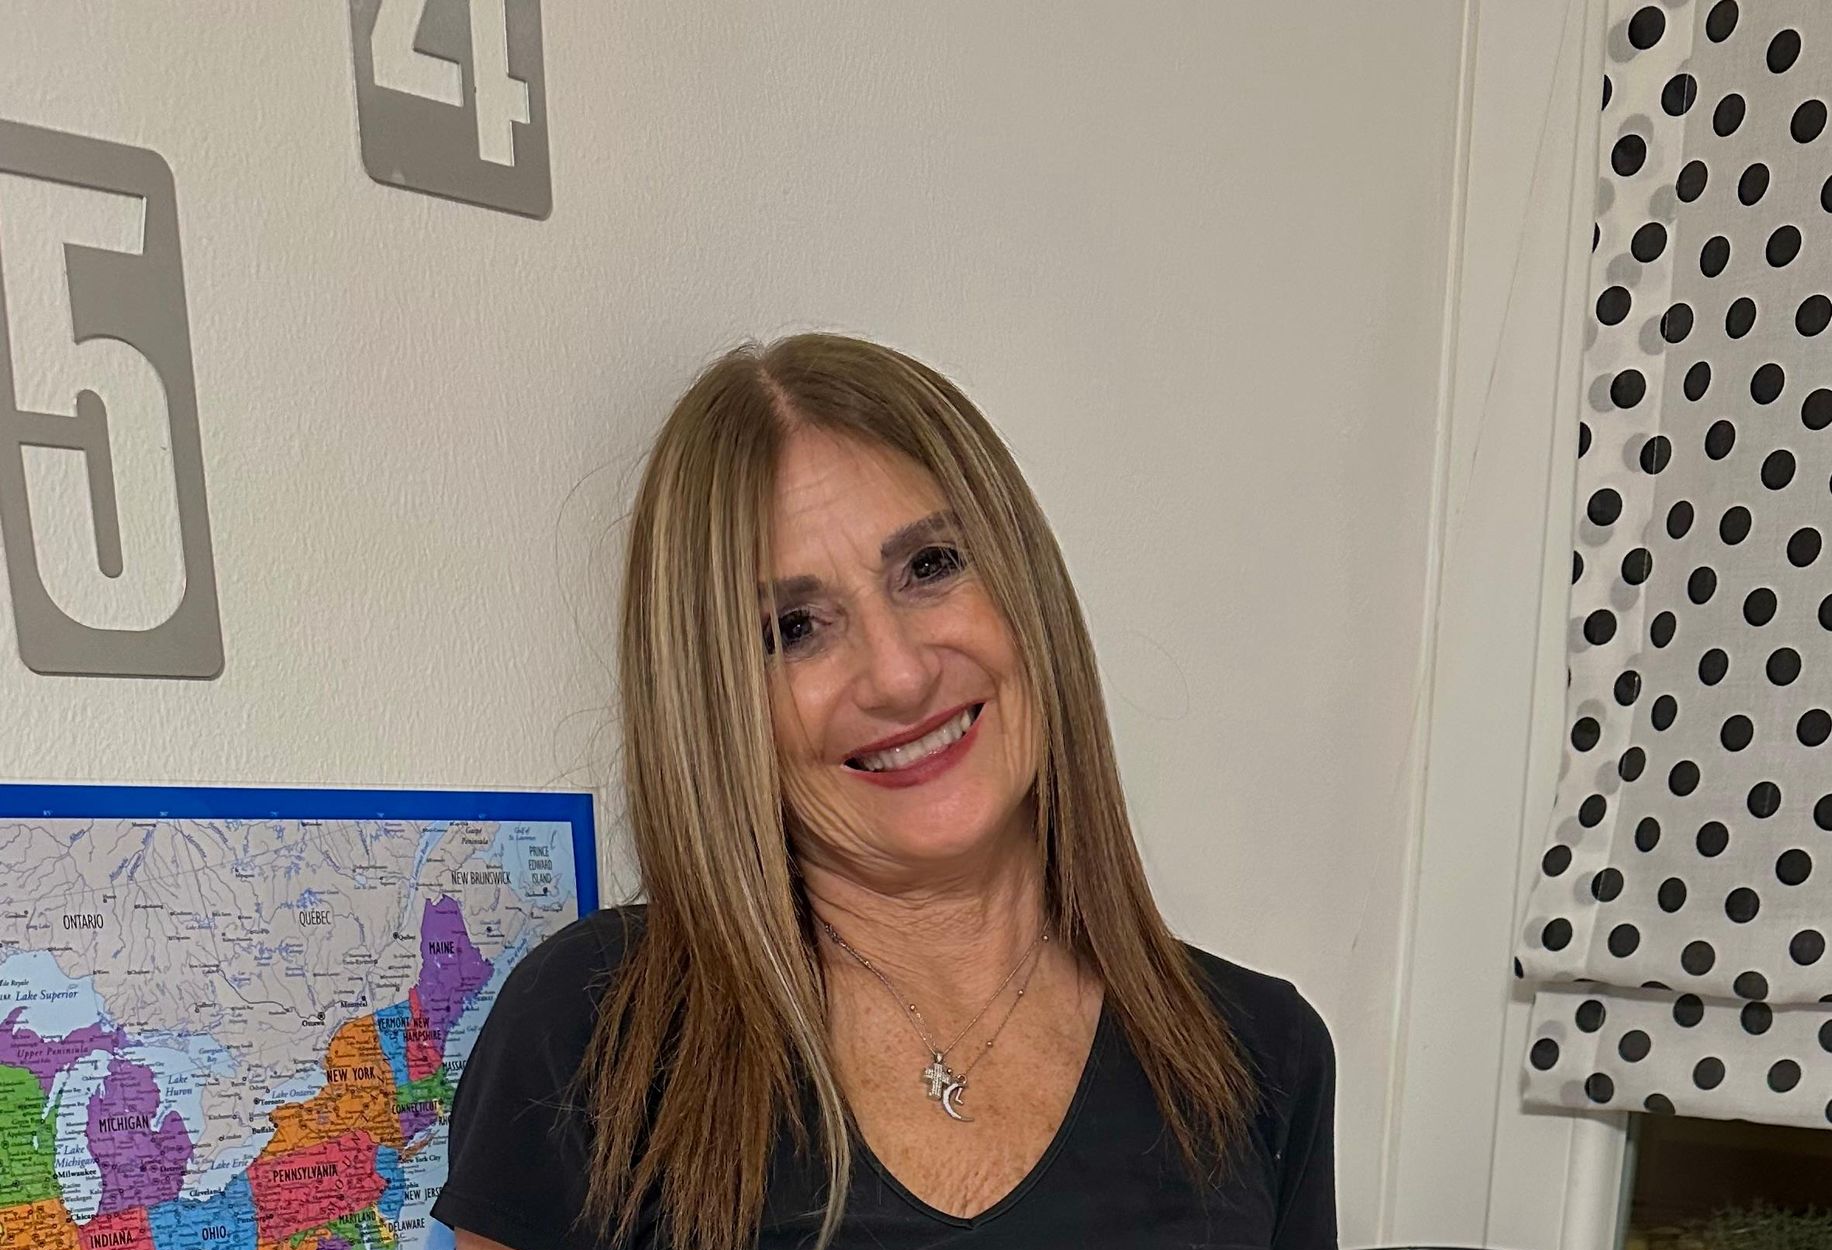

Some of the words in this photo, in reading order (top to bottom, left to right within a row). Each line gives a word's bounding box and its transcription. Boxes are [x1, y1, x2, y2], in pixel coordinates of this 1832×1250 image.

[0, 170, 187, 631] 5
[528, 845, 550, 857] PRINCE
[528, 859, 553, 871] EDWARD
[451, 871, 469, 885] NEW
[470, 871, 512, 885] BRUNSWICK
[531, 873, 552, 884] ISLAND
[63, 913, 104, 930] ONTARIO
[299, 910, 332, 926] QUÉBEC
[429, 941, 455, 955] MAINE
[15, 990, 38, 1001] Lake
[40, 989, 79, 1003] Superior
[377, 1017, 410, 1030] VERMONT
[413, 1016, 430, 1028] NEW
[403, 1029, 442, 1041] HAMPSHIRE
[17, 1049, 43, 1060] Upper
[47, 1046, 89, 1056] Peninsula
[168, 1075, 188, 1085] Lake
[326, 1069, 349, 1083] NEW
[352, 1066, 376, 1080] YORK
[165, 1087, 193, 1097] Huron
[272, 1090, 289, 1099] Lake
[289, 1089, 316, 1098] Ontario
[392, 1101, 437, 1115] CONNECTICUT
[99, 1115, 150, 1133] MICHIGAN
[252, 1126, 275, 1135] Buffalo
[64, 1145, 85, 1155] Lake
[55, 1157, 97, 1169] Michigan
[429, 1154, 441, 1162] City
[211, 1161, 231, 1170] Lake
[232, 1160, 249, 1169] Erie
[58, 1169, 97, 1178] Milwaukee
[272, 1164, 338, 1183] PENNSYLVANIA
[404, 1188, 421, 1201] NEW
[339, 1211, 376, 1225] MARYLAND
[388, 1217, 425, 1233] DELAWARE
[90, 1230, 133, 1249] INDIANA
[202, 1226, 228, 1241] OHIO
